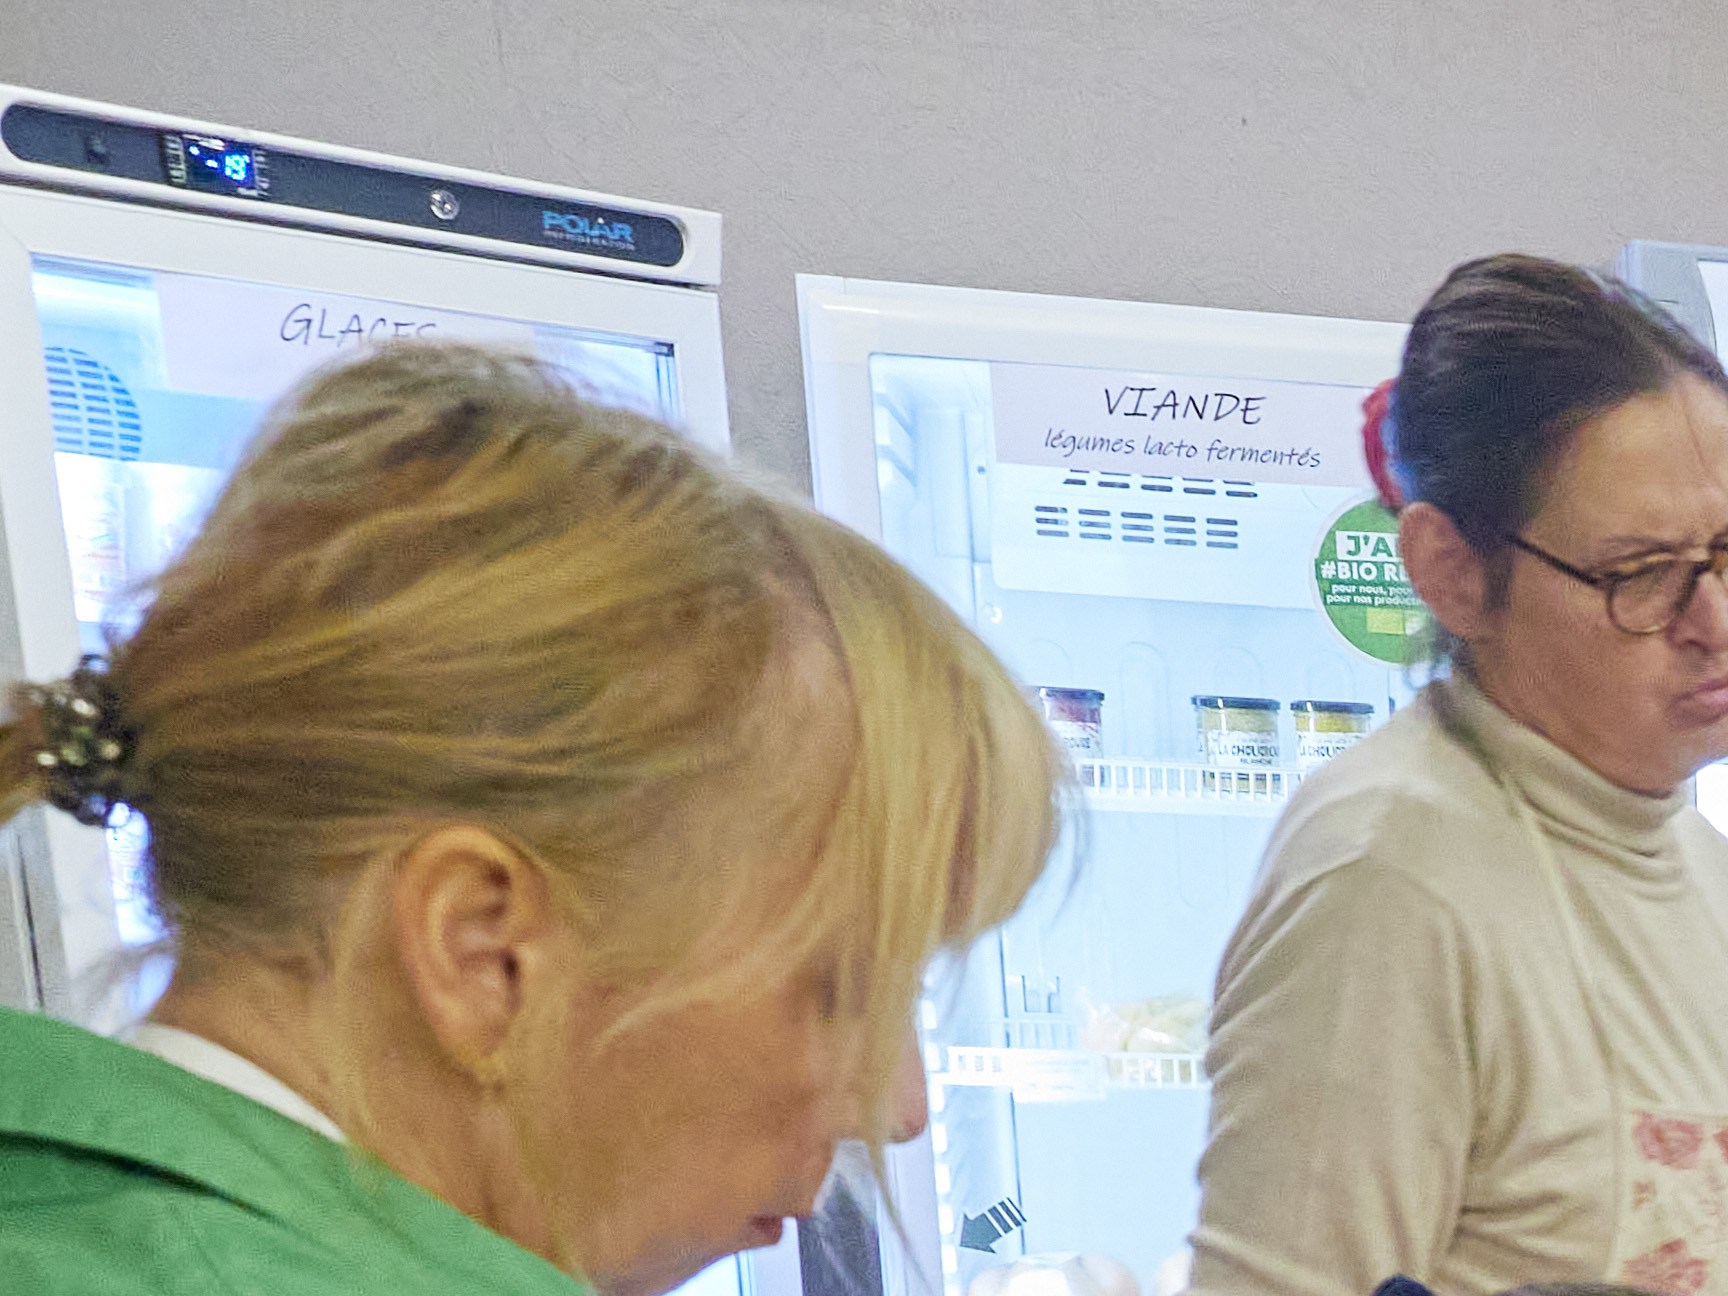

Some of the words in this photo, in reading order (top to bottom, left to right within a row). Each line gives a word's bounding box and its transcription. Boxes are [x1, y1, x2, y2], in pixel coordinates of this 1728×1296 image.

[542, 211, 634, 243] POLAR
[1104, 386, 1267, 424] VIANDE
[1044, 427, 1136, 458] légumes
[1143, 435, 1199, 458] lacto
[1206, 439, 1322, 468] fermentés
[1346, 535, 1398, 558] J'A
[1320, 560, 1378, 582] #BIO
